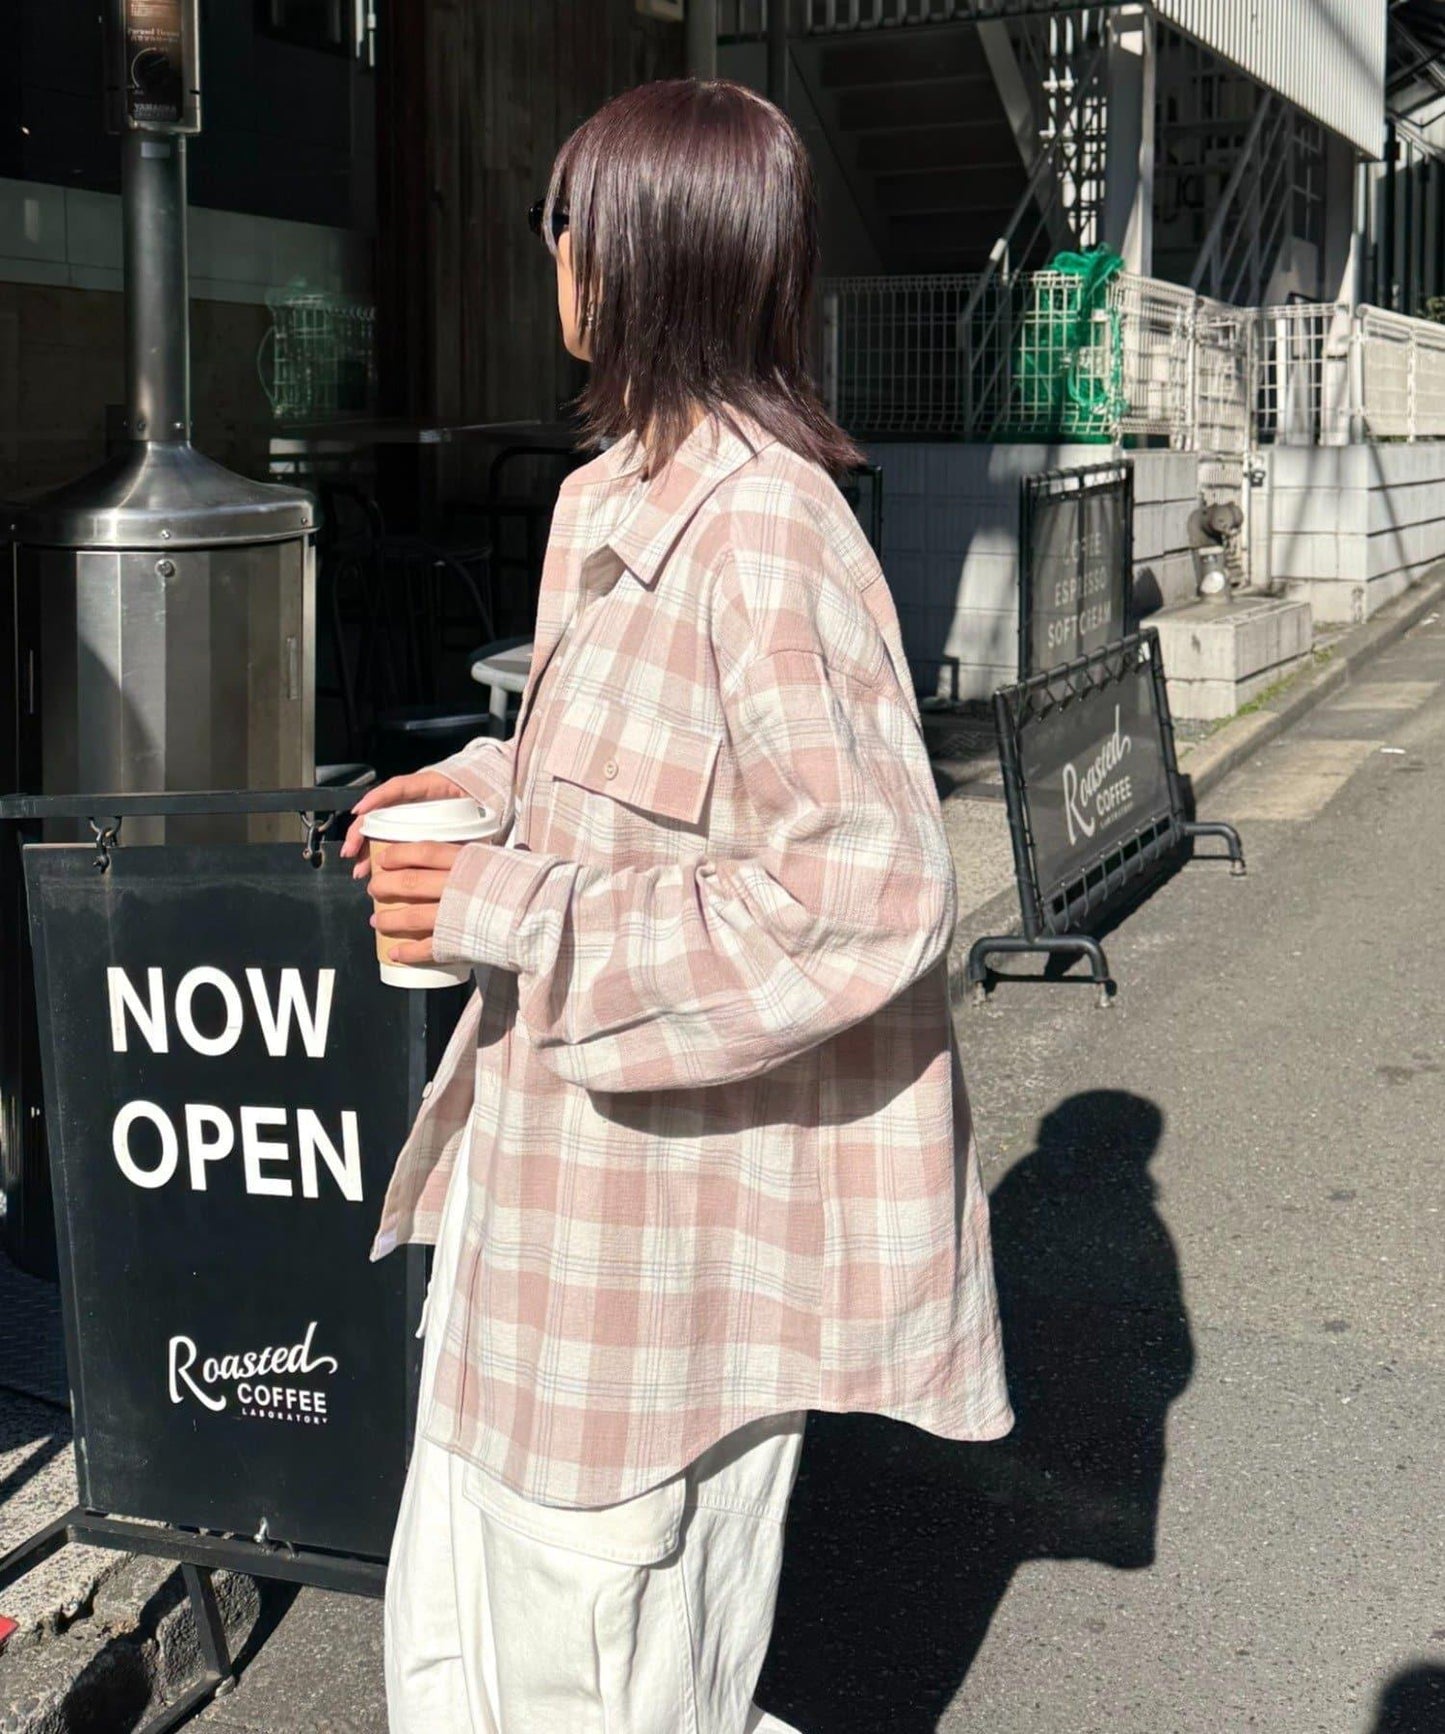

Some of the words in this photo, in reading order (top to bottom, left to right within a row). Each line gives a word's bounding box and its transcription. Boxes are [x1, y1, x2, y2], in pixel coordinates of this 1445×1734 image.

[1047, 614, 1079, 649] SOFT
[1062, 703, 1132, 846] Roasted
[1096, 775, 1133, 816] COFFEE
[107, 965, 336, 1058] NOW
[112, 1099, 364, 1202] OPEN
[168, 1321, 338, 1412] Roasted
[237, 1383, 328, 1414] COFFEE
[242, 1407, 329, 1425] LABORATORY
